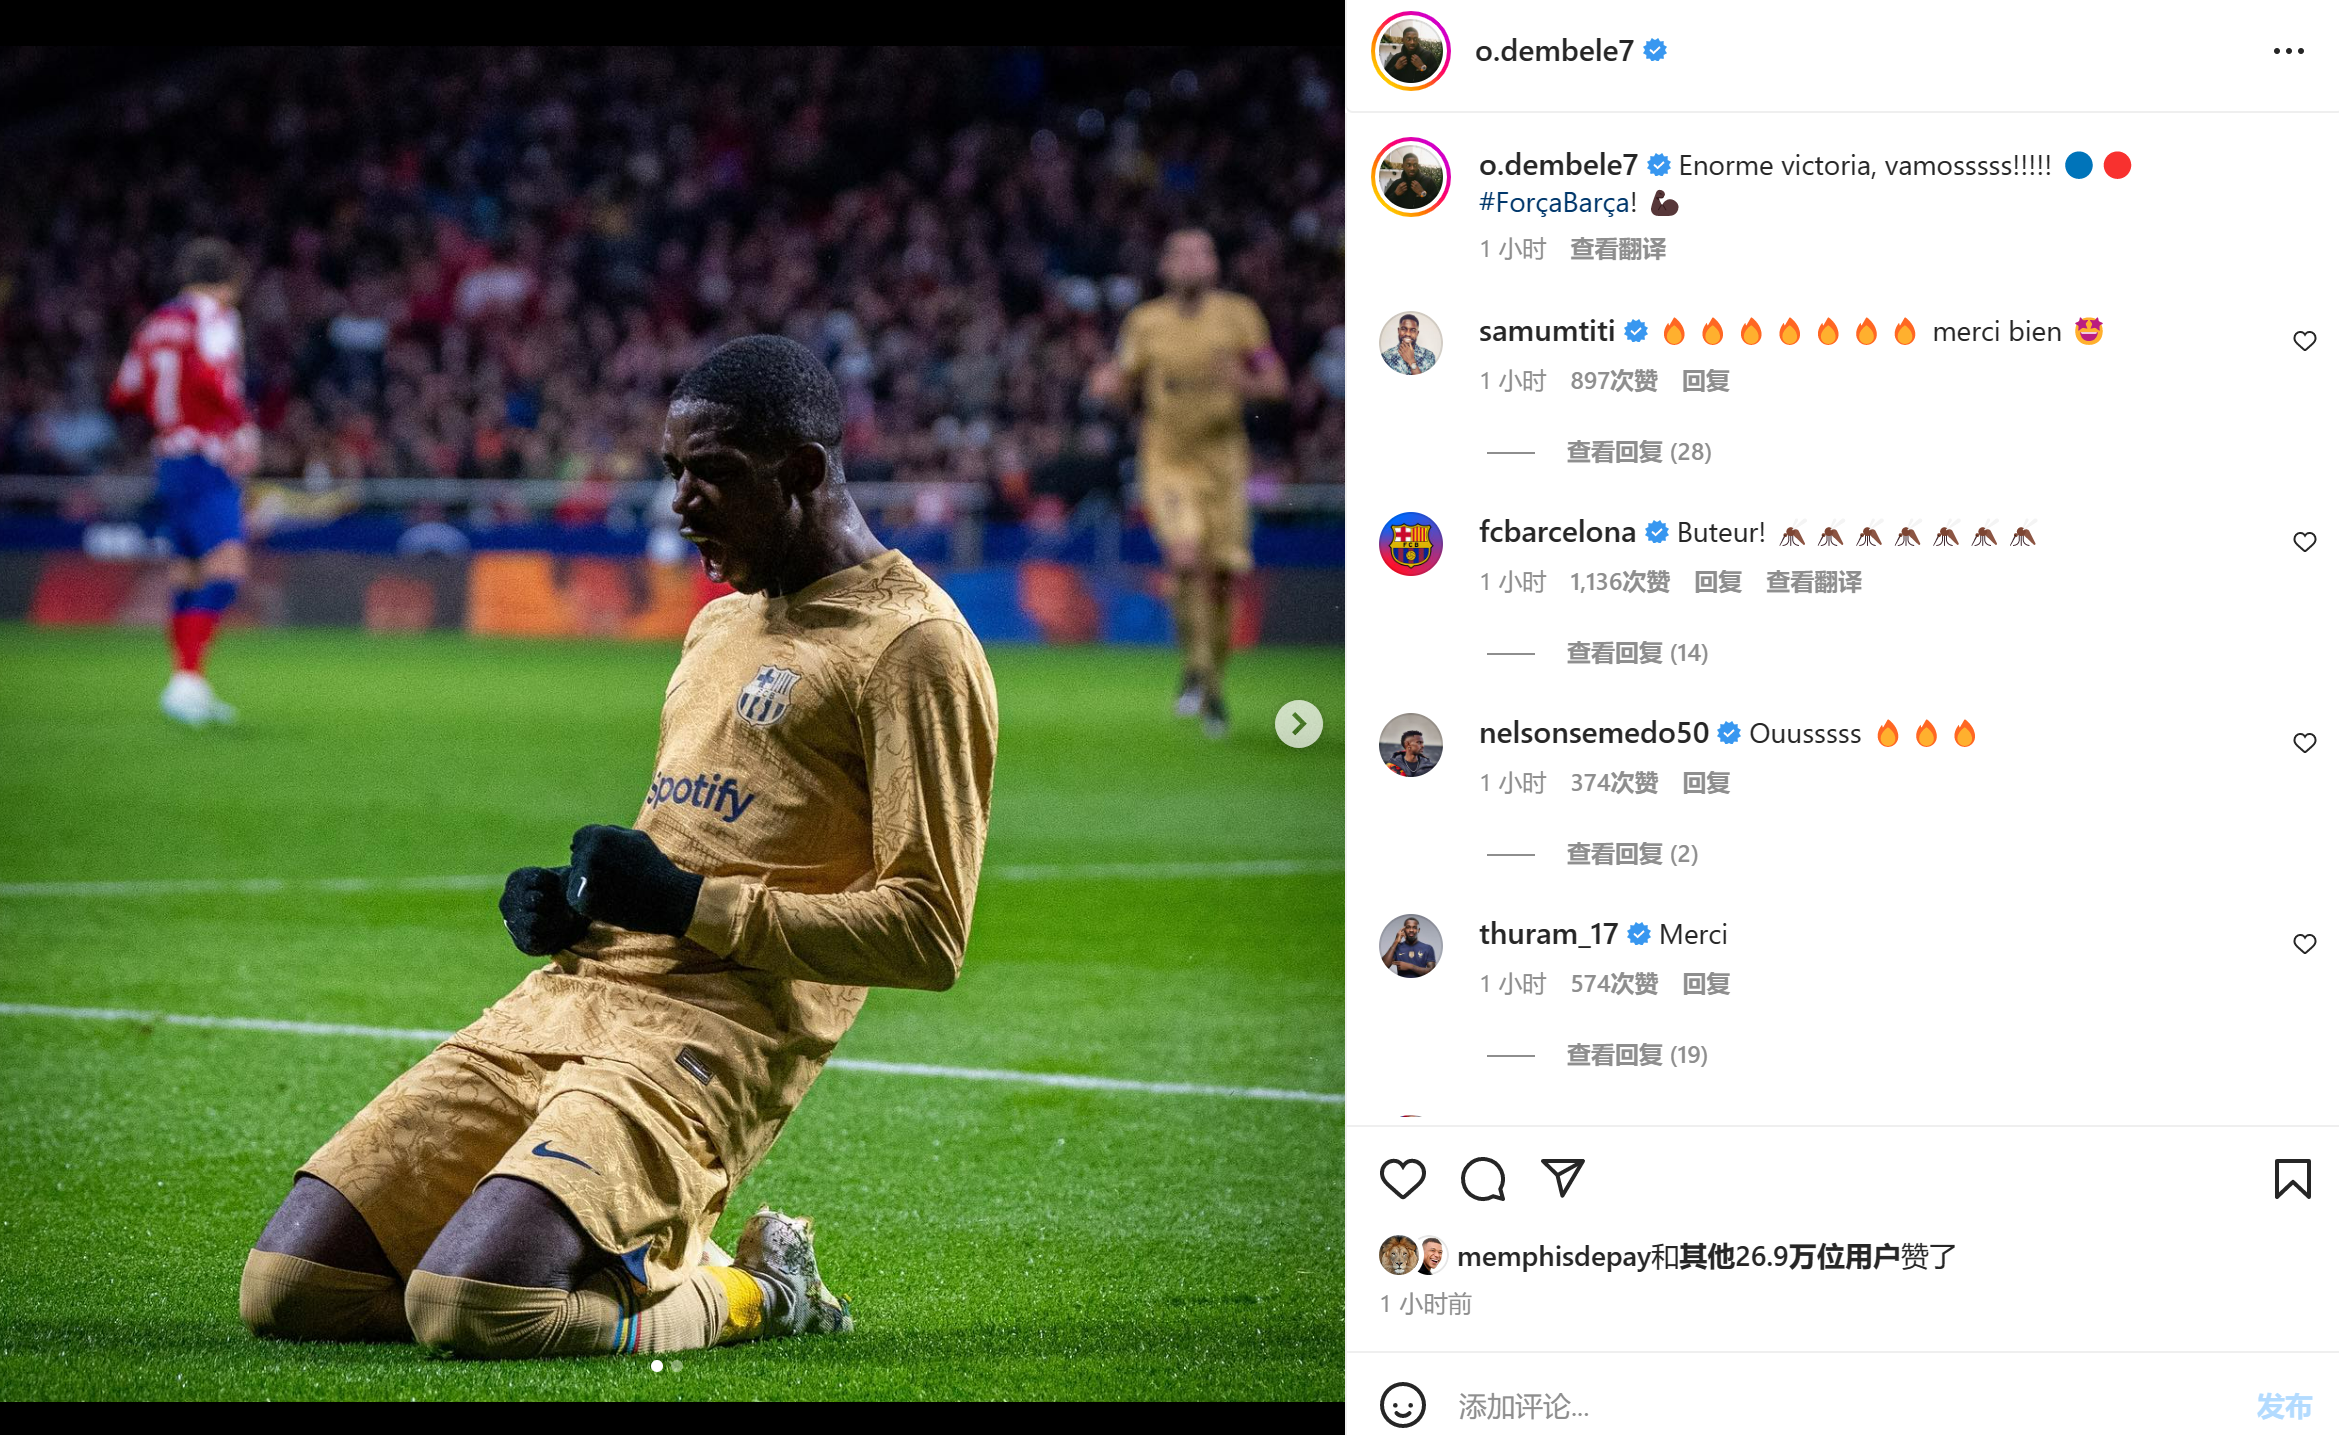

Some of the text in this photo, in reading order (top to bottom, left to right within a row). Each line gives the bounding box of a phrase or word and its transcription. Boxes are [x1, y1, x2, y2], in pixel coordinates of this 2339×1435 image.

[1476, 38, 1634, 61] o.dembele7
[1480, 152, 2050, 179] o.dembele7 Enorme victoria, vamosssss!!!!!
[1479, 192, 1636, 217] #ForçaBarça!
[1481, 237, 1666, 260] 1 小时 查看翻译
[1480, 319, 2061, 341] samumtiti merci bien
[1481, 369, 1730, 392] 1 小时 897次赞 回复
[1567, 440, 1711, 464] 查看回复 (28)
[1479, 519, 1764, 542] fcbarcelona Buteur!
[1481, 570, 1862, 593] 1 小时 1,136次赞 回复 查看翻译
[1567, 641, 1708, 665] 查看回复 (14)
[1481, 720, 1861, 743] nelsonsemedo50 Ouusssss
[1481, 771, 1730, 794] 1 小时 374次赞 回复
[1567, 842, 1698, 866] 查看回复 (2)
[1479, 921, 1727, 948] thuram_17 Merci
[1481, 972, 1730, 995] 1 小时 574次赞 回复
[1567, 1043, 1707, 1067] 查看回复 (19)
[1381, 1292, 1472, 1315] 1 小时前
[1459, 1393, 1588, 1420] 添加评论...
[2257, 1393, 2312, 1420] 发布
